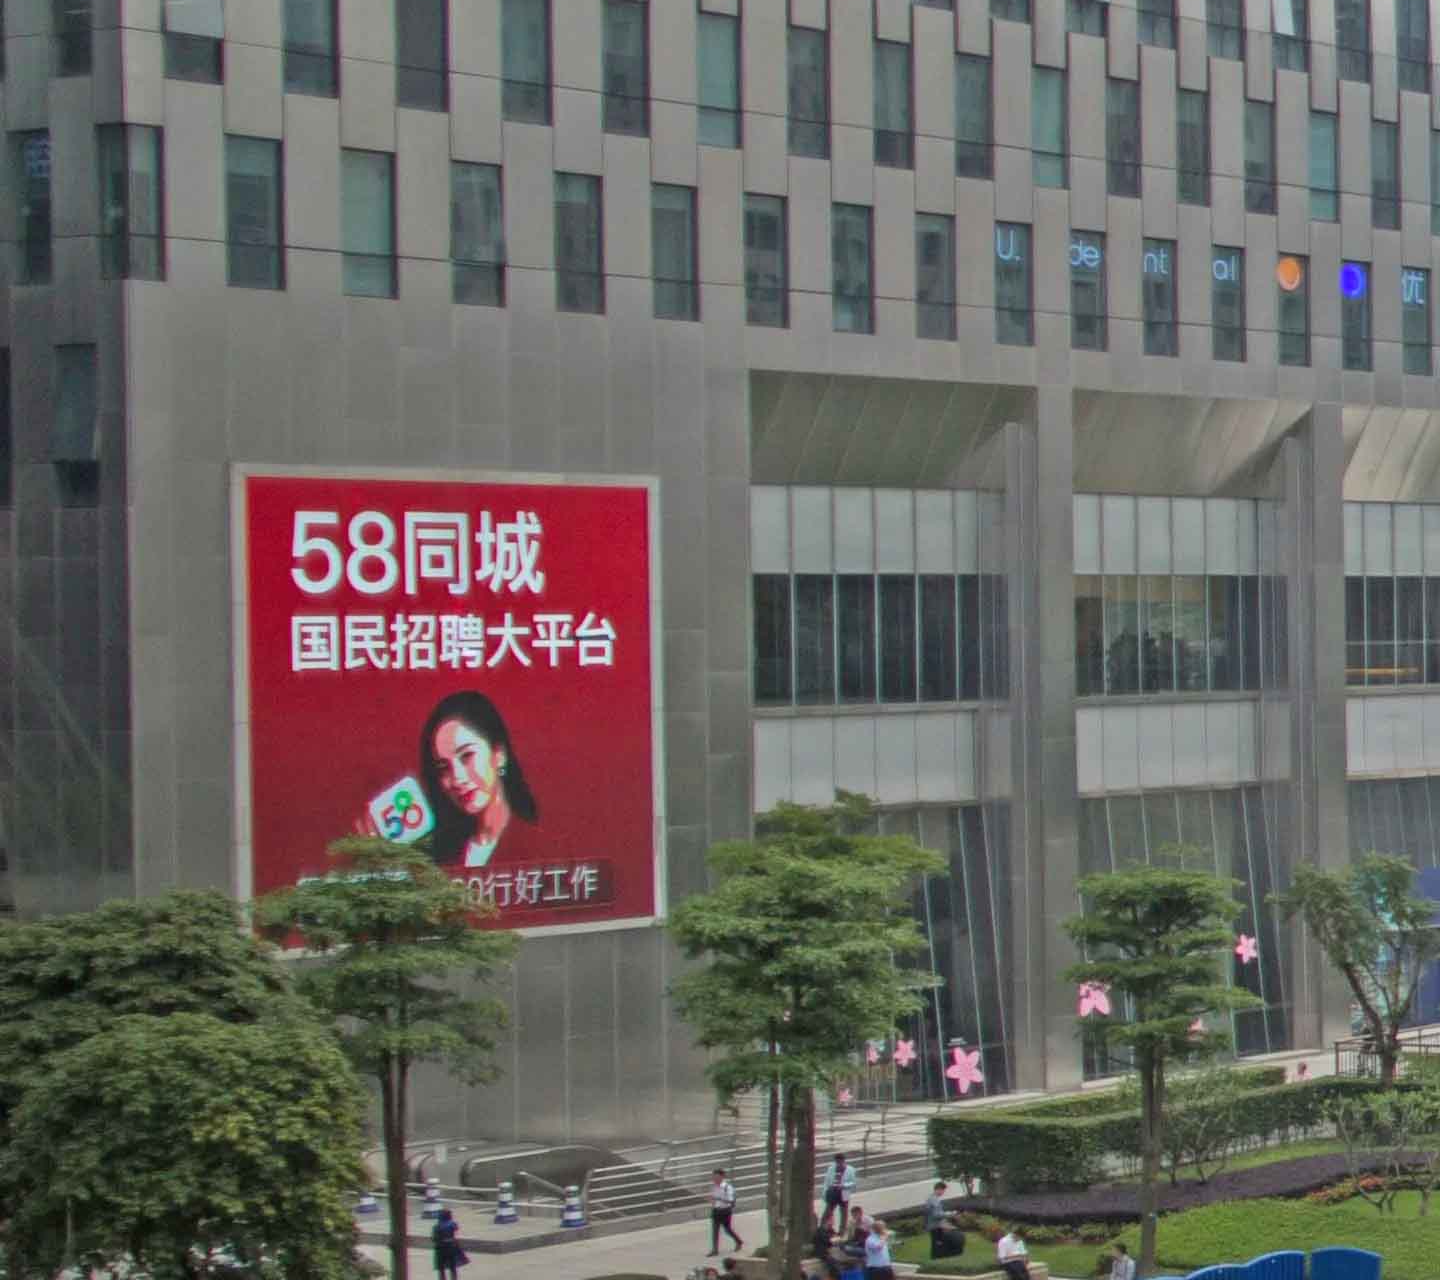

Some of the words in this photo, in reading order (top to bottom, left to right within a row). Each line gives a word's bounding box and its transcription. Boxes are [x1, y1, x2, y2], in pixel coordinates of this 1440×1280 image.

[290, 510, 545, 595] 58同城
[289, 612, 617, 672] 国民招聘大平台
